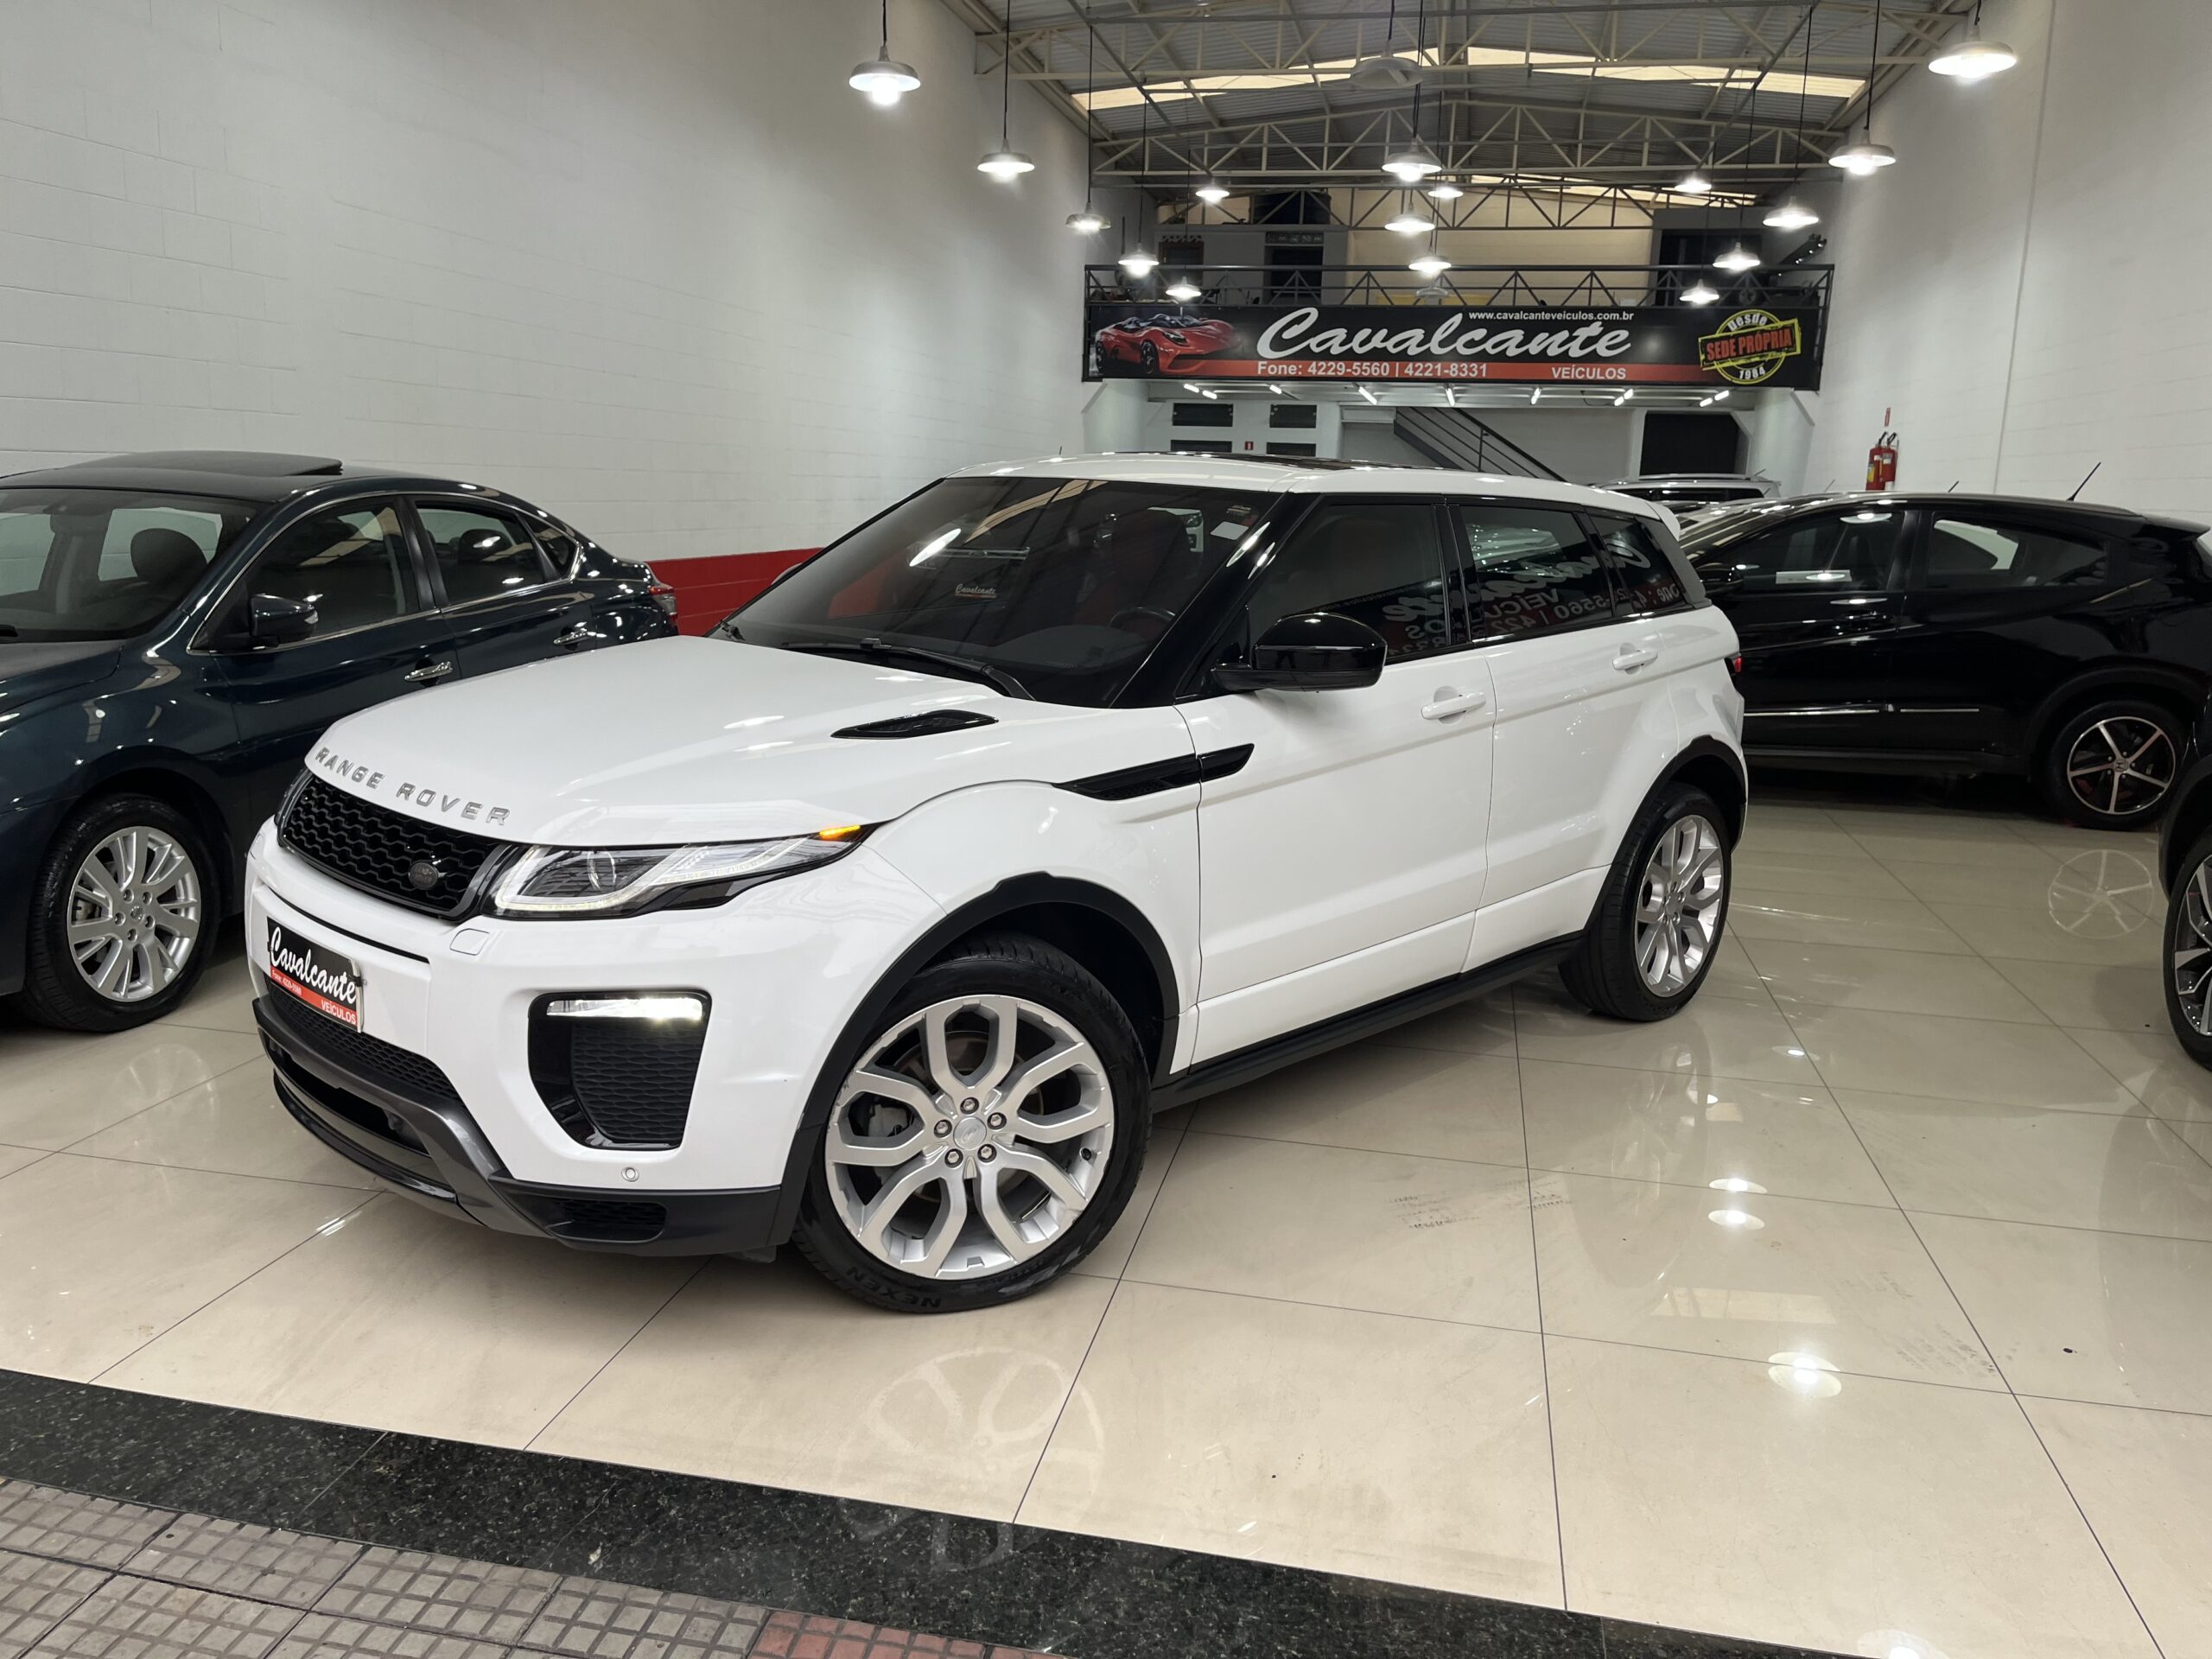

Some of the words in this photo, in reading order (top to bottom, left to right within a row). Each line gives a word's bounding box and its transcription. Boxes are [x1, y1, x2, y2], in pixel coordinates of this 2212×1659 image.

[1469, 311, 1634, 321] www.cavalcanteveiculos.com.br
[1726, 313, 1768, 331] Desde
[1256, 307, 1631, 359] Cavalcante
[1706, 338, 1737, 361] SEDE
[1738, 328, 1793, 355] PRÓPRIA
[1257, 360, 1302, 375] Fone:
[1307, 361, 1390, 377] 4229-5560
[1404, 362, 1488, 378] 4221-8331
[1551, 365, 1627, 380] VEÍCULOS
[1739, 366, 1765, 379] 1984
[315, 747, 385, 789] RANGE
[396, 782, 511, 826] ROVER
[270, 926, 357, 1004] Cavalcante
[321, 999, 357, 1025] VEÍCULOS
[846, 1266, 941, 1307] NEXEN
